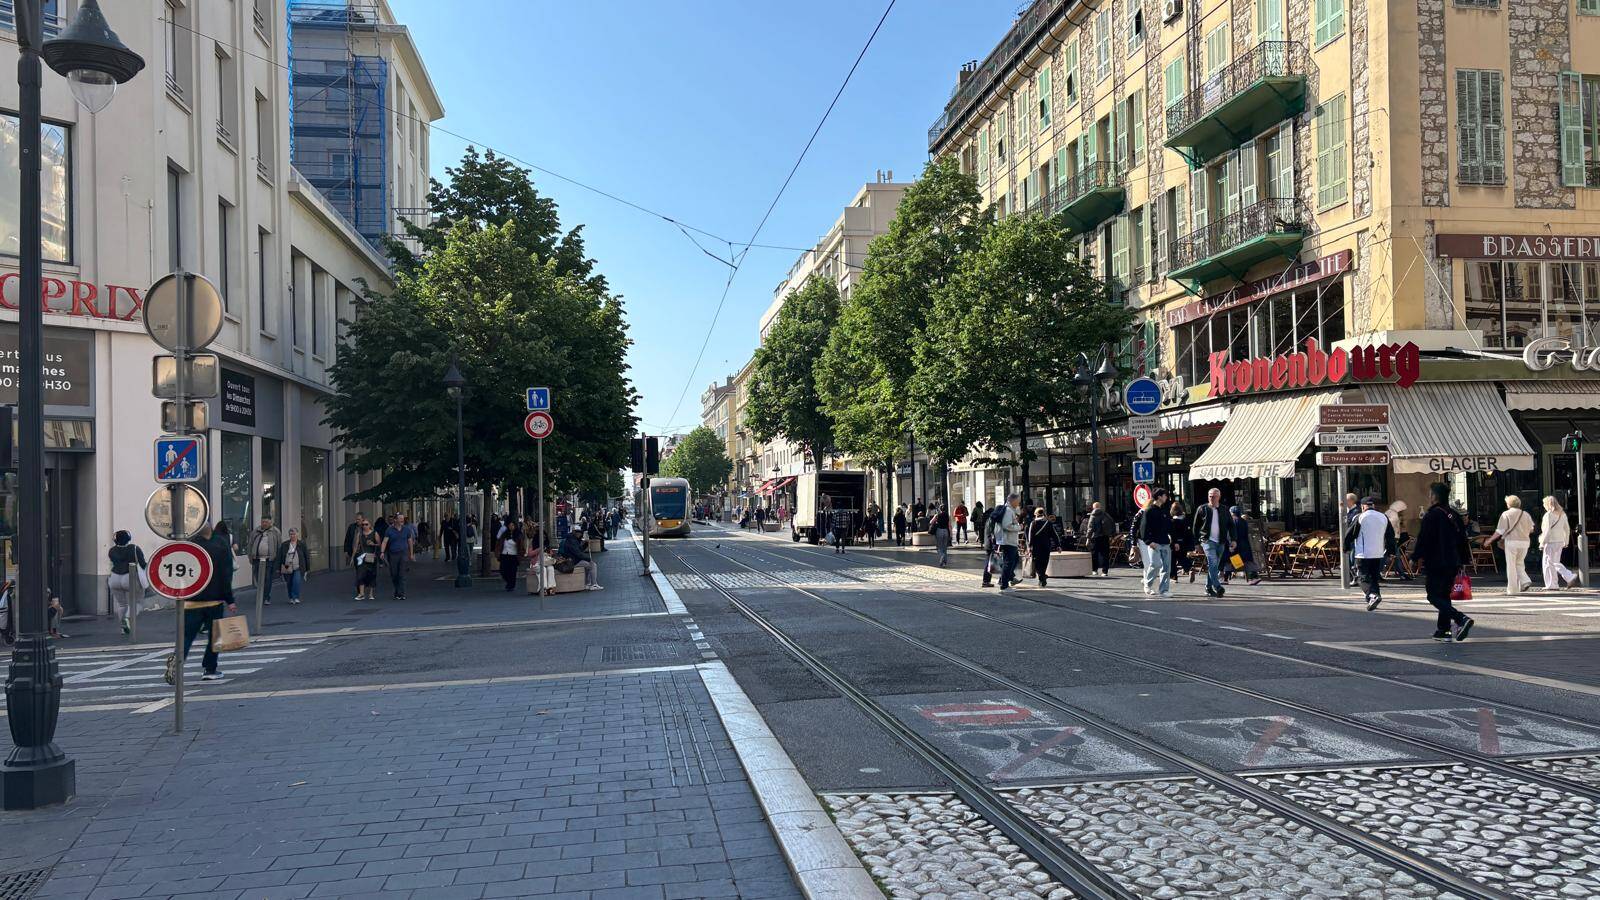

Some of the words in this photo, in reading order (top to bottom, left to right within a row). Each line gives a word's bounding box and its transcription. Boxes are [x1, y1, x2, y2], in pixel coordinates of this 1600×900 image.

[1295, 265, 1312, 285] DE
[1207, 336, 1420, 398] Kronenbourg
[1200, 466, 1237, 478] SALON
[1238, 465, 1254, 476] DE
[1257, 464, 1280, 476] THE
[1429, 457, 1498, 471] GLACIER
[164, 563, 187, 578] 19
